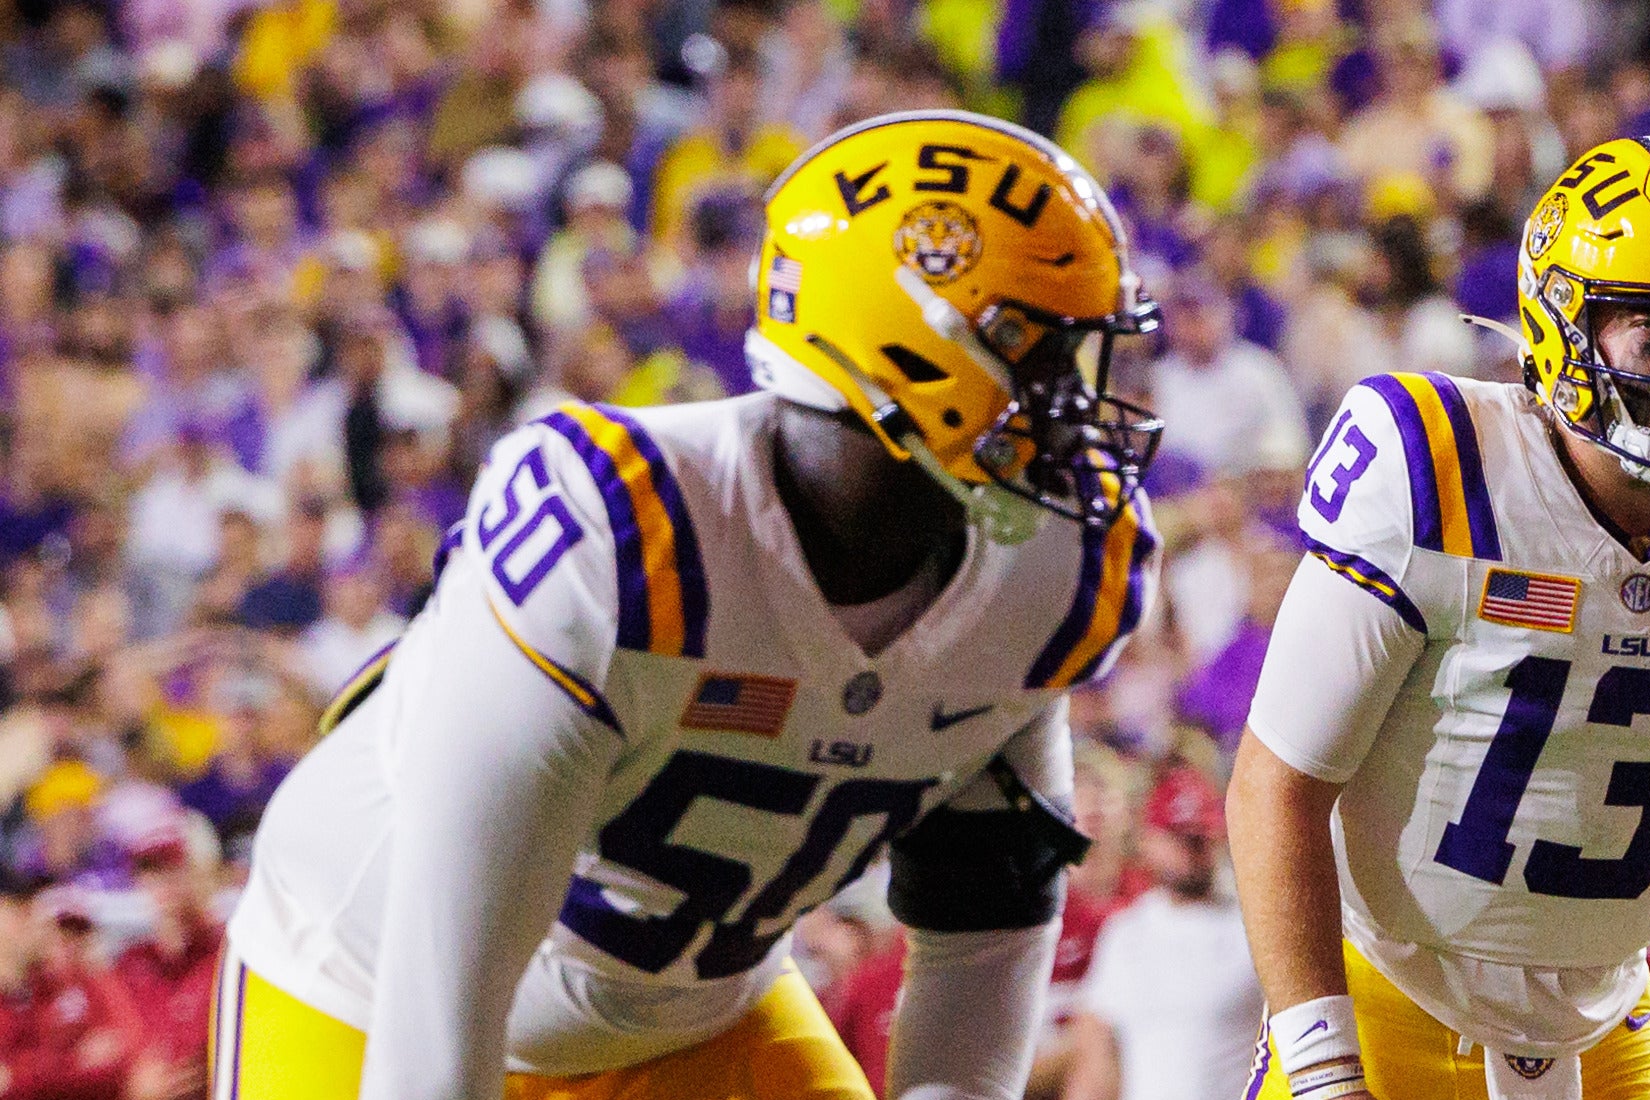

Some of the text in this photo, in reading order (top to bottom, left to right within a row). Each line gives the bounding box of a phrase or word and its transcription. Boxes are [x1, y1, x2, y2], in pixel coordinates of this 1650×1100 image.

[479, 446, 584, 608] 50
[1304, 408, 1378, 524] 13
[809, 738, 874, 768] LSU
[557, 749, 941, 980] 50
